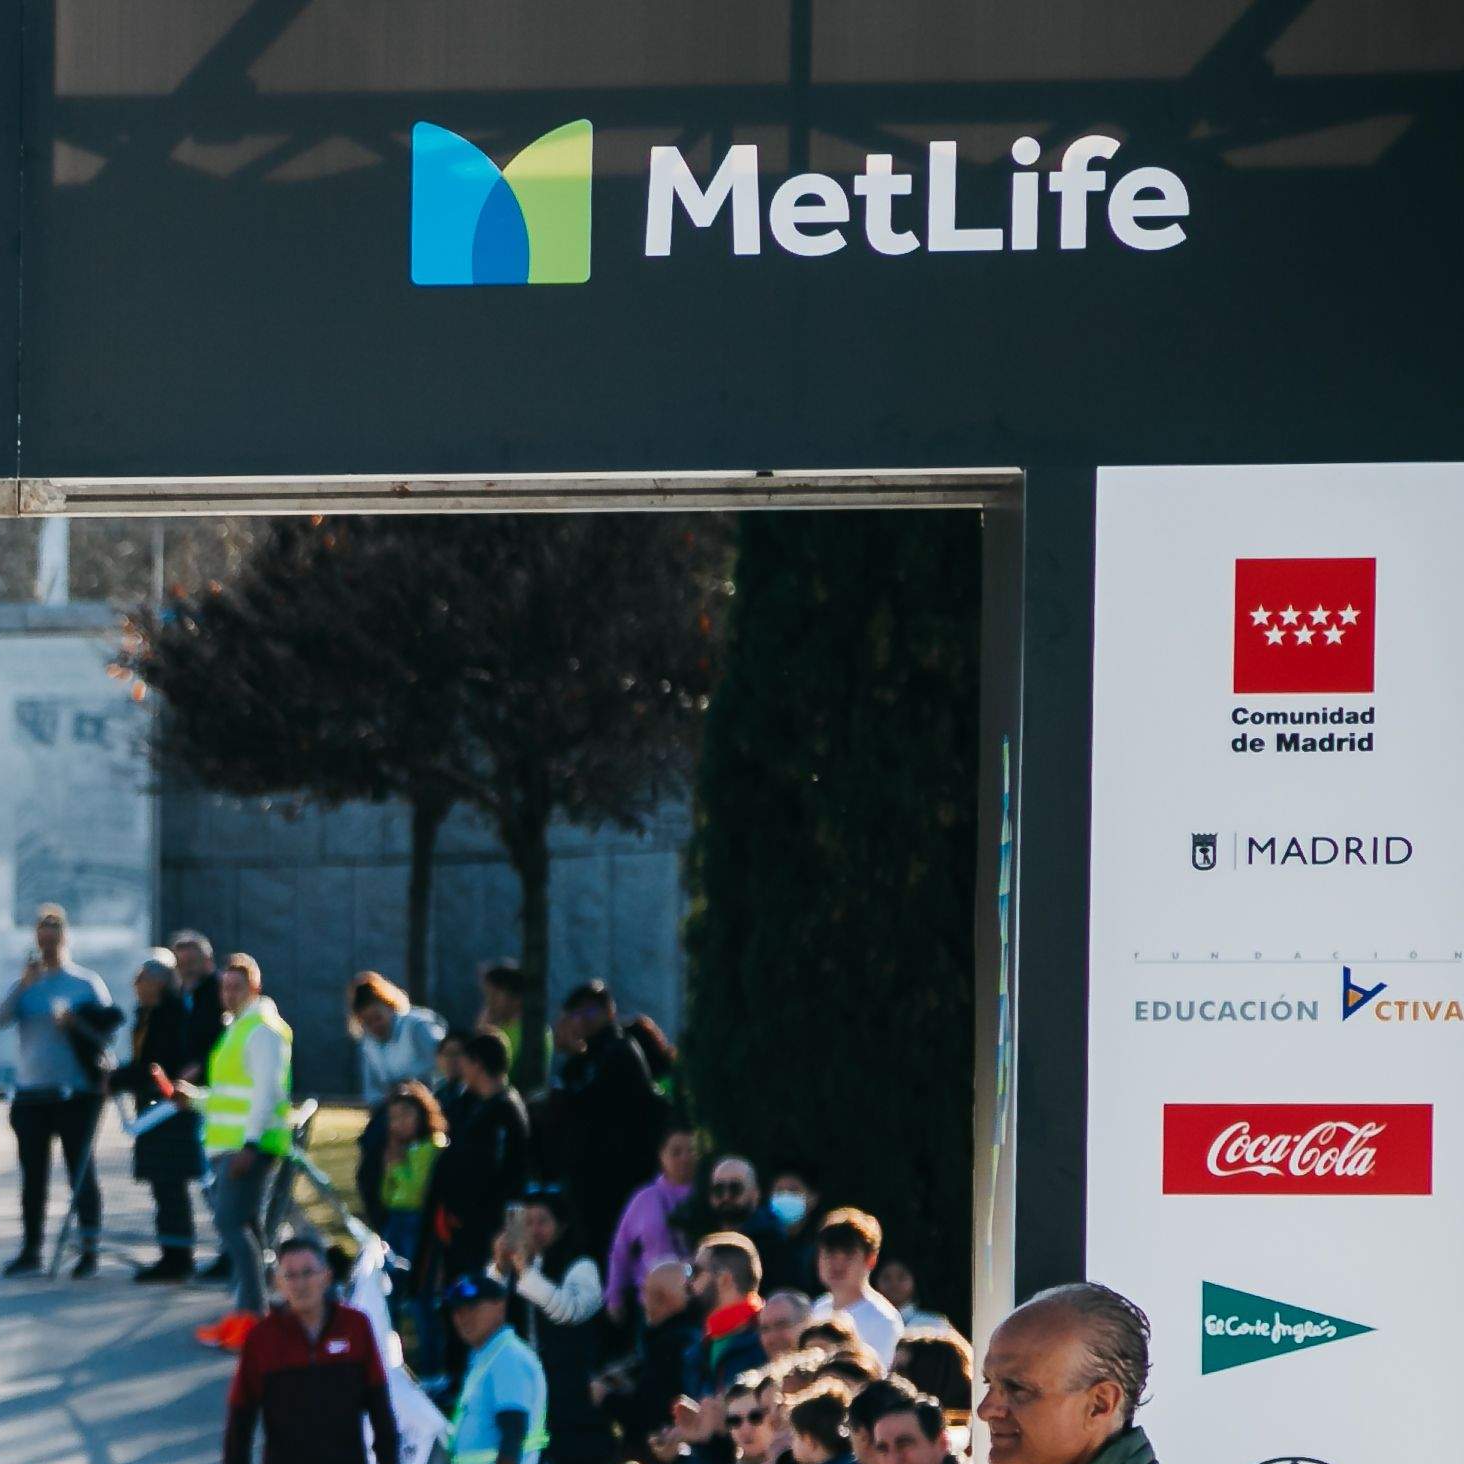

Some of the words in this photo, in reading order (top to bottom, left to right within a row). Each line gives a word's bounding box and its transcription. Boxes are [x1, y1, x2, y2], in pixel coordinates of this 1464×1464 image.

[643, 134, 1191, 258] MetLife
[1230, 706, 1376, 726] Comunidad
[1230, 733, 1266, 754] de
[1276, 732, 1375, 754] Madrid
[1247, 836, 1414, 866] MADRID
[1134, 994, 1319, 1023] EDUCACIÓN
[1206, 1120, 1387, 1178] Coca-Cola
[1204, 1314, 1225, 1336] El
[1225, 1315, 1271, 1337] Corte
